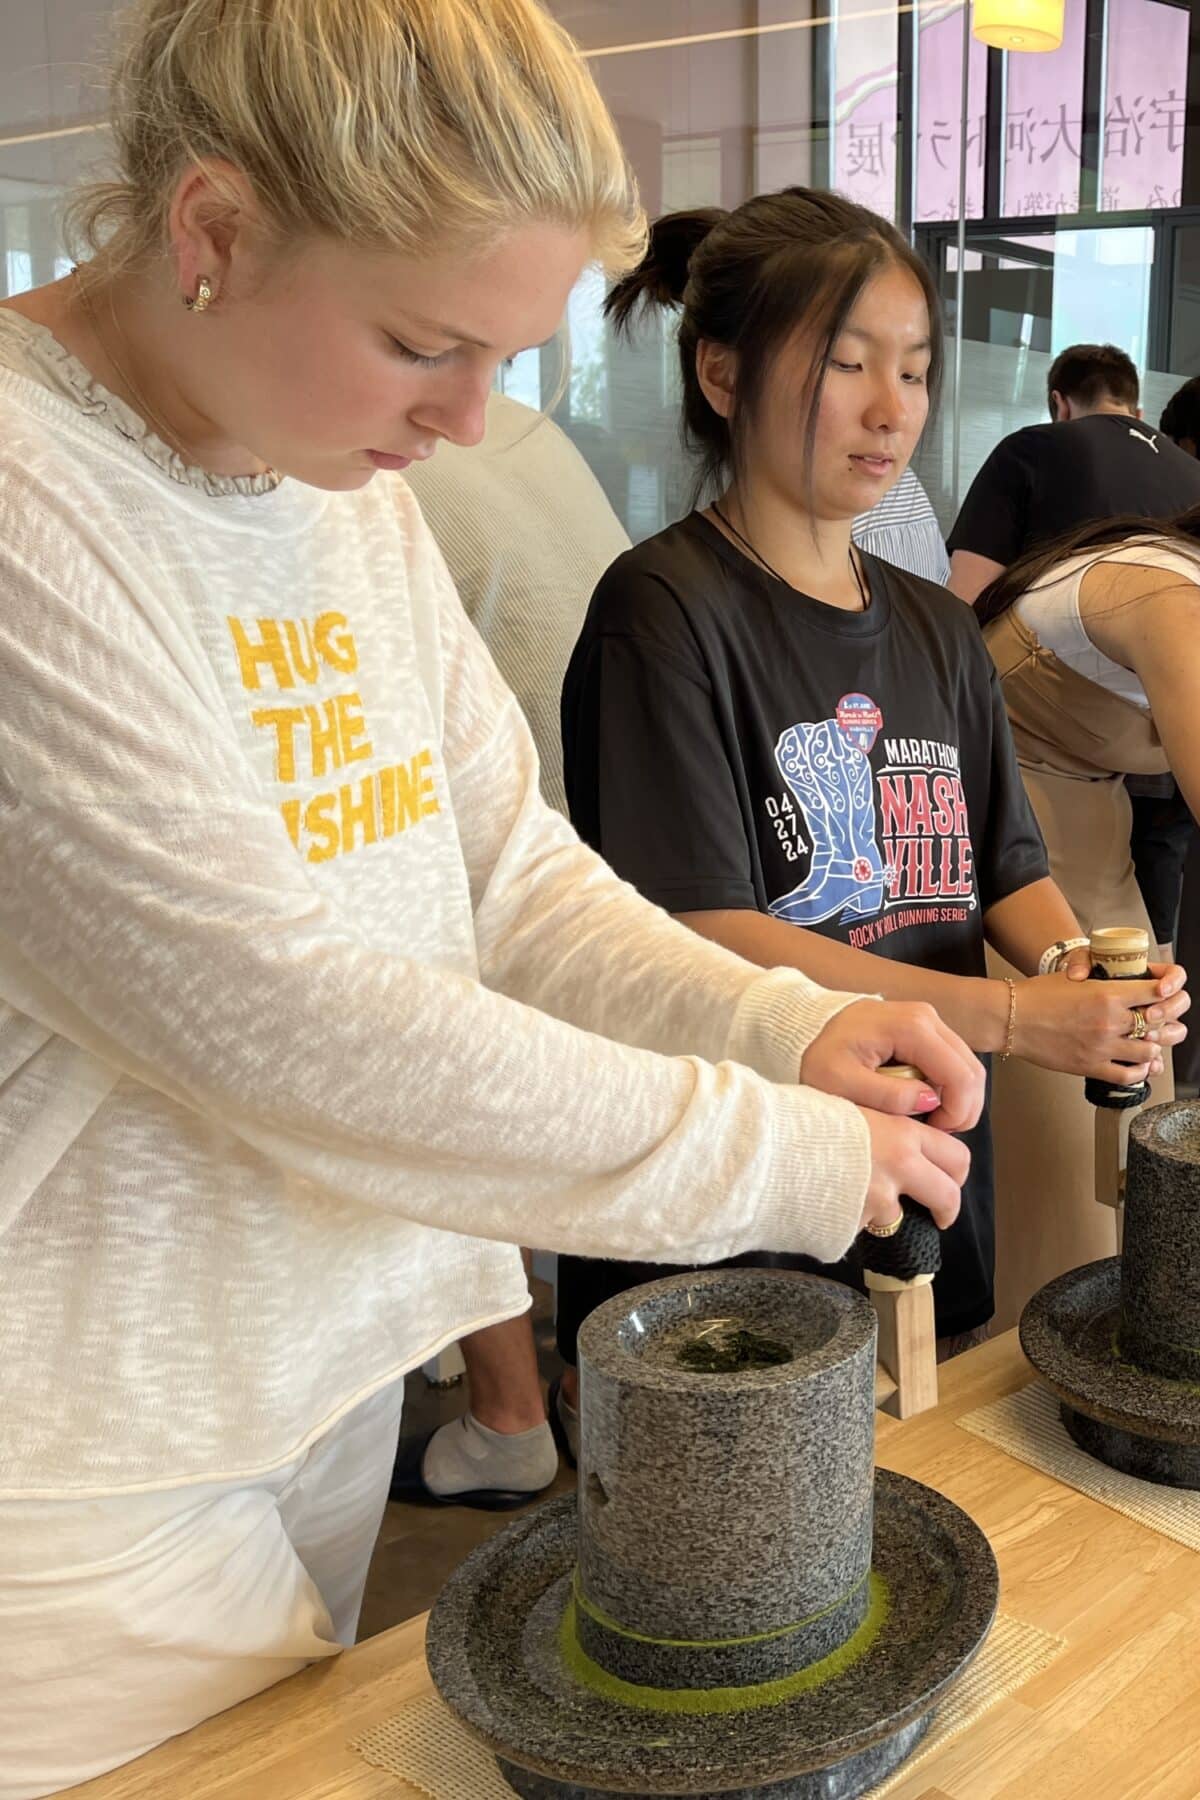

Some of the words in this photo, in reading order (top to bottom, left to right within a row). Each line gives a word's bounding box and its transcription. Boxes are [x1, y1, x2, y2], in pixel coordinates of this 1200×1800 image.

[227, 611, 358, 690] HUG
[251, 692, 374, 784] THE
[884, 738, 959, 769] MARATHON
[765, 792, 794, 818] 04
[773, 812, 798, 840] 27
[877, 774, 969, 837] NASH
[782, 834, 809, 862] 24
[883, 838, 973, 898] VILLE
[848, 925, 876, 949] ROCK
[898, 907, 939, 929] RUNNING
[940, 907, 968, 922] SERIES
